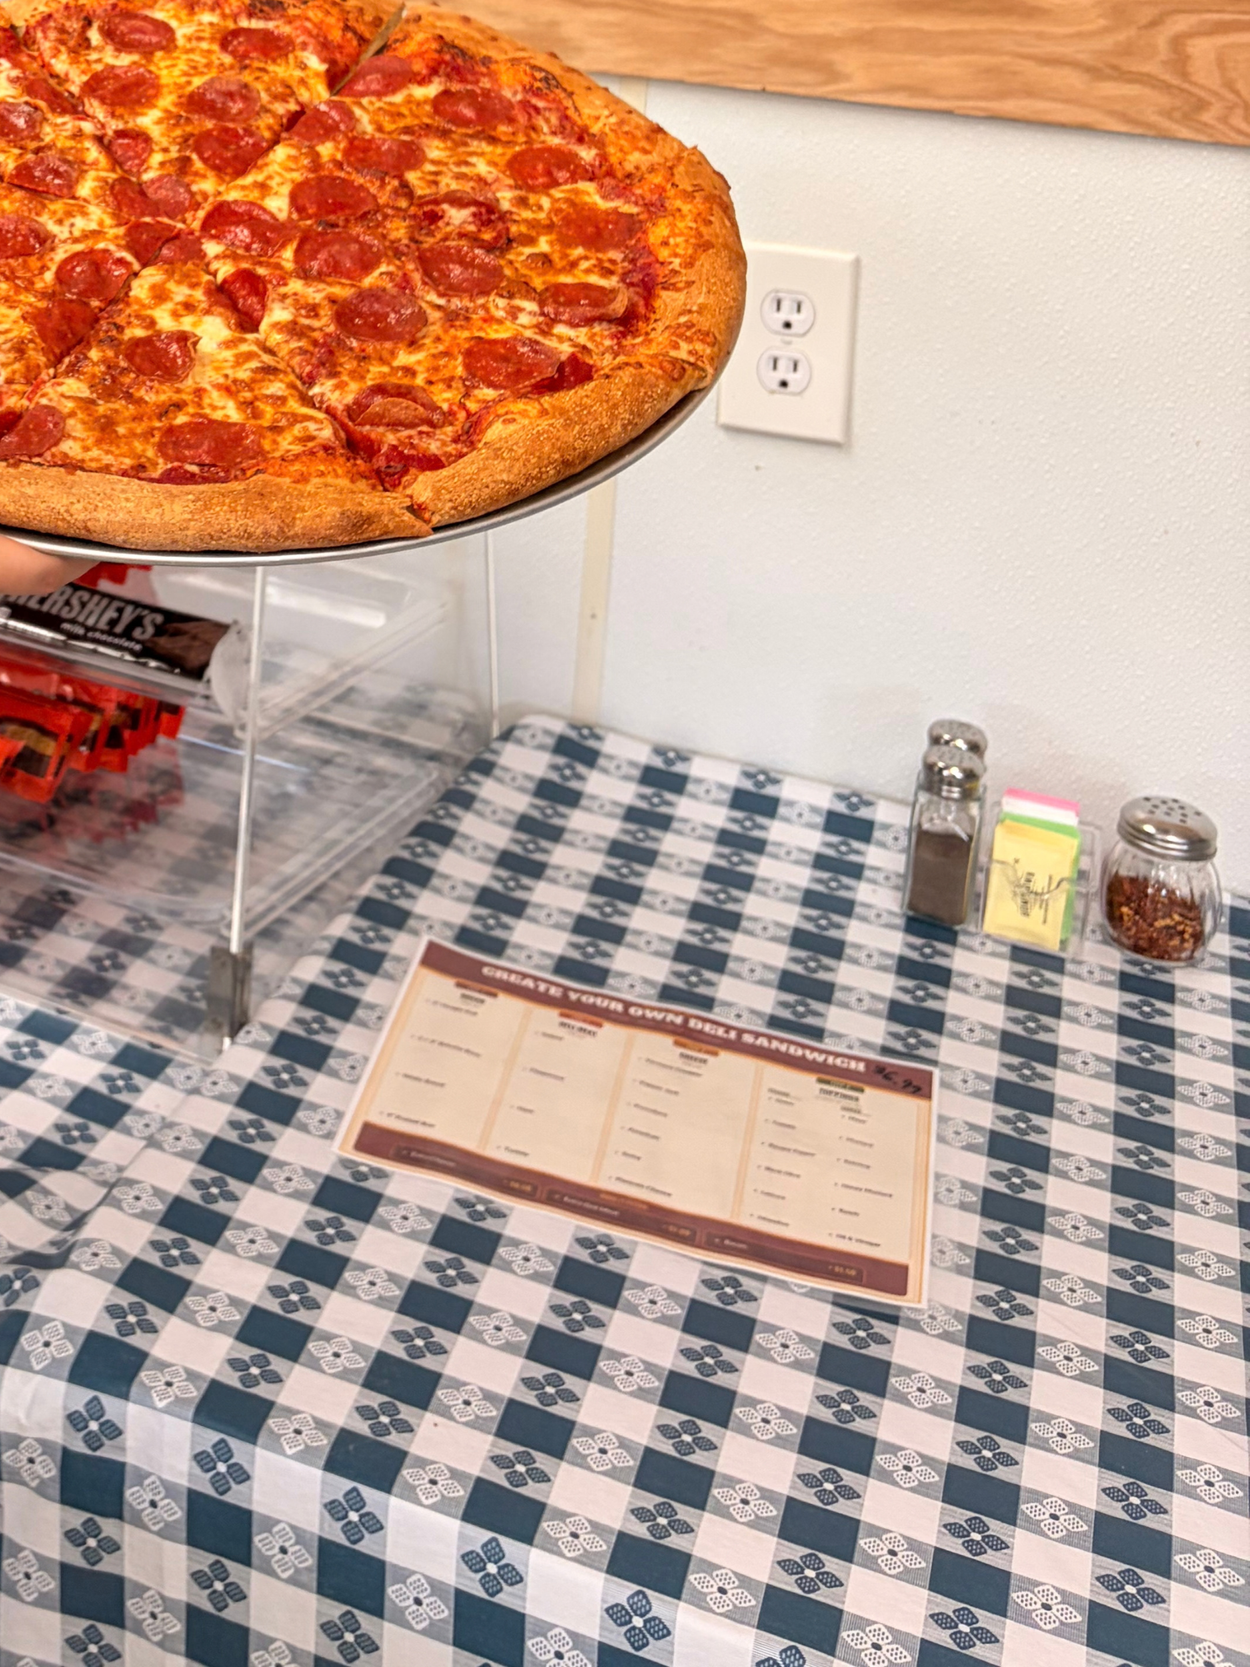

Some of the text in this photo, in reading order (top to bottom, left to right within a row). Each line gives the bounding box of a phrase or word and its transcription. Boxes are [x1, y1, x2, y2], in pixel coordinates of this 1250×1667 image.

[60, 621, 143, 652] milk chocolate
[481, 965, 564, 999] CREATE
[566, 985, 625, 1014] YOUR
[628, 1005, 685, 1027] OWN
[687, 1017, 738, 1042] DELI
[740, 1031, 867, 1074] SANDWICH
